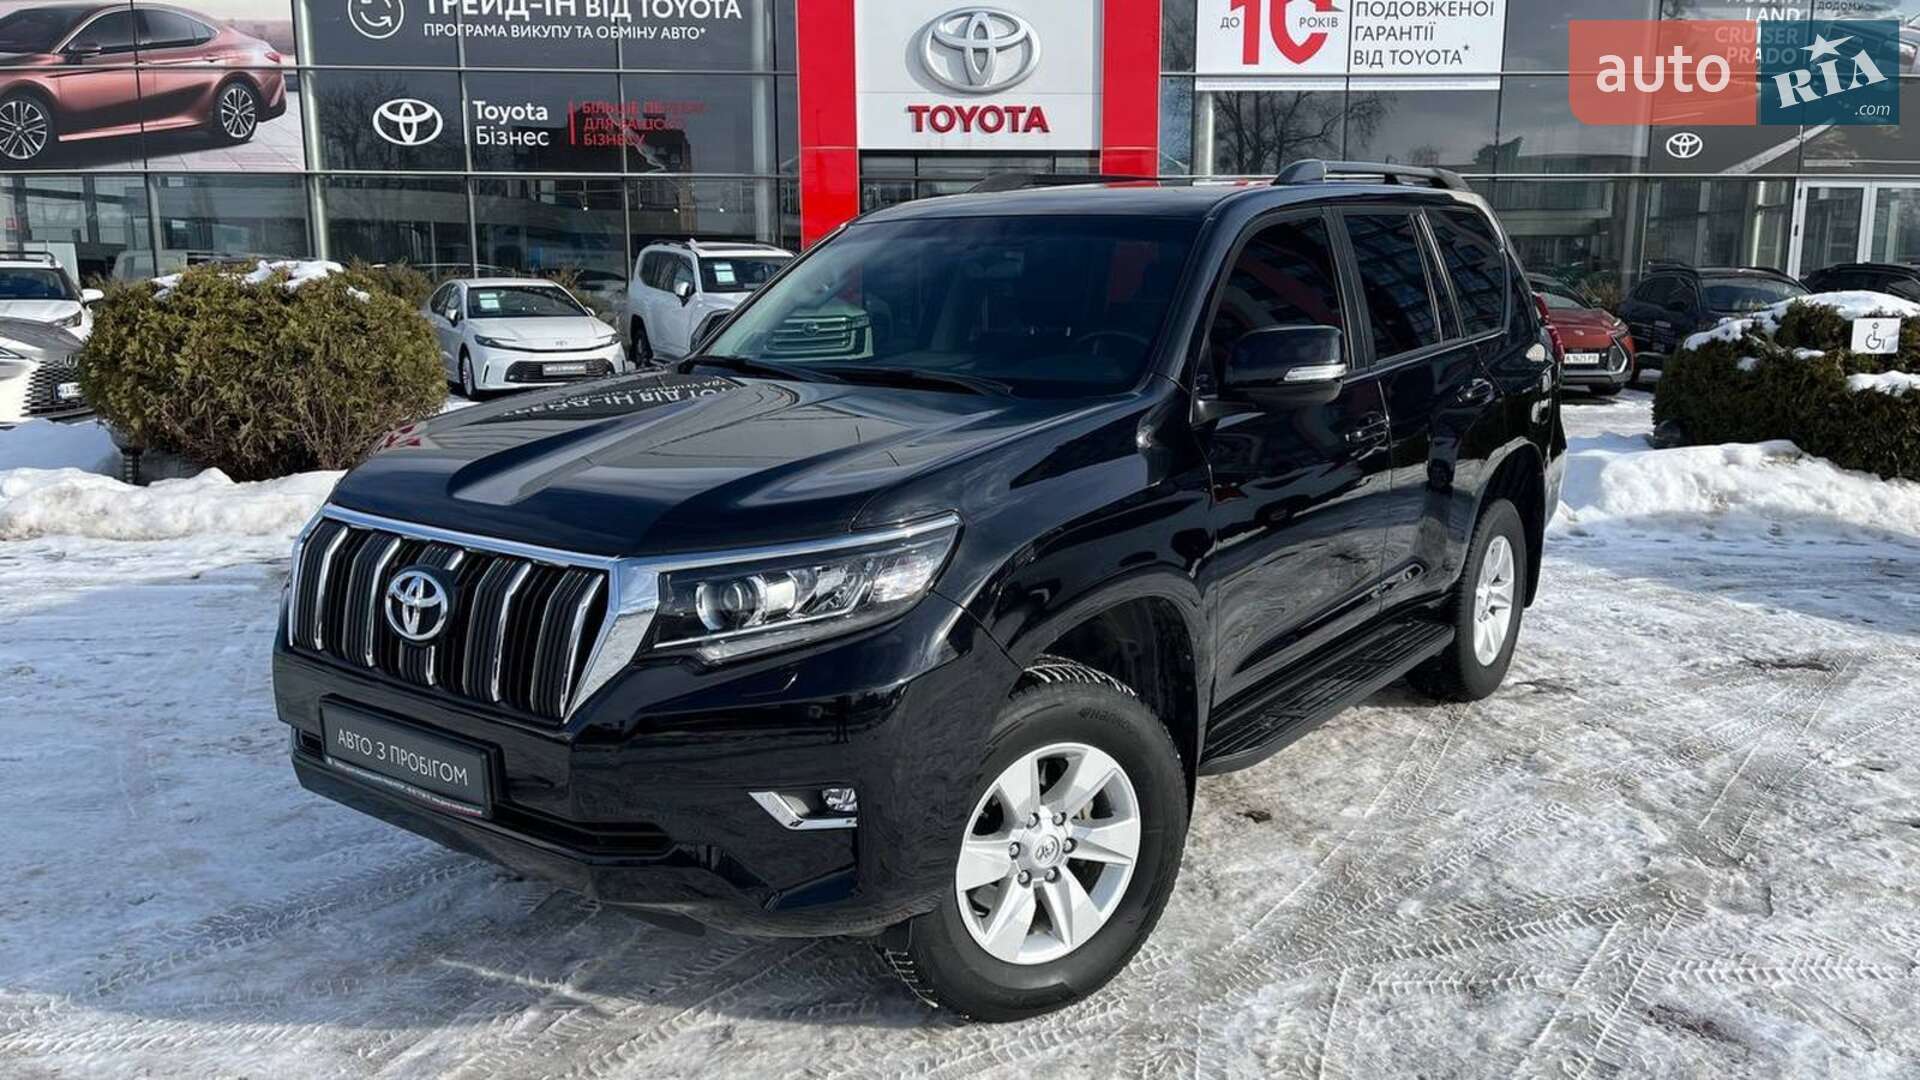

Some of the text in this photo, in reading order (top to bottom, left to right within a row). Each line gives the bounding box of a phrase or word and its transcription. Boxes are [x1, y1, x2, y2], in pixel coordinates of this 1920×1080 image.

[586, 0, 632, 23] ВІД
[639, 0, 743, 19] TOYOTA
[424, 23, 507, 37] ПРОГРАМА
[511, 24, 573, 39] ВИКУПУ
[575, 25, 594, 39] ТА
[596, 25, 658, 39] ОБМІНУ
[1220, 17, 1241, 29] ДО
[1299, 17, 1339, 28] РОКІВ
[1355, 22, 1437, 41] ГАРАНТІЇ
[1354, 50, 1384, 69] ВІД
[472, 100, 549, 125] Toyota
[907, 104, 1050, 134] TOYOTA
[476, 126, 550, 146] Бізнес
[337, 728, 373, 756] АВТО
[376, 742, 387, 760] З
[389, 745, 469, 786] ПРОБІГОМ
